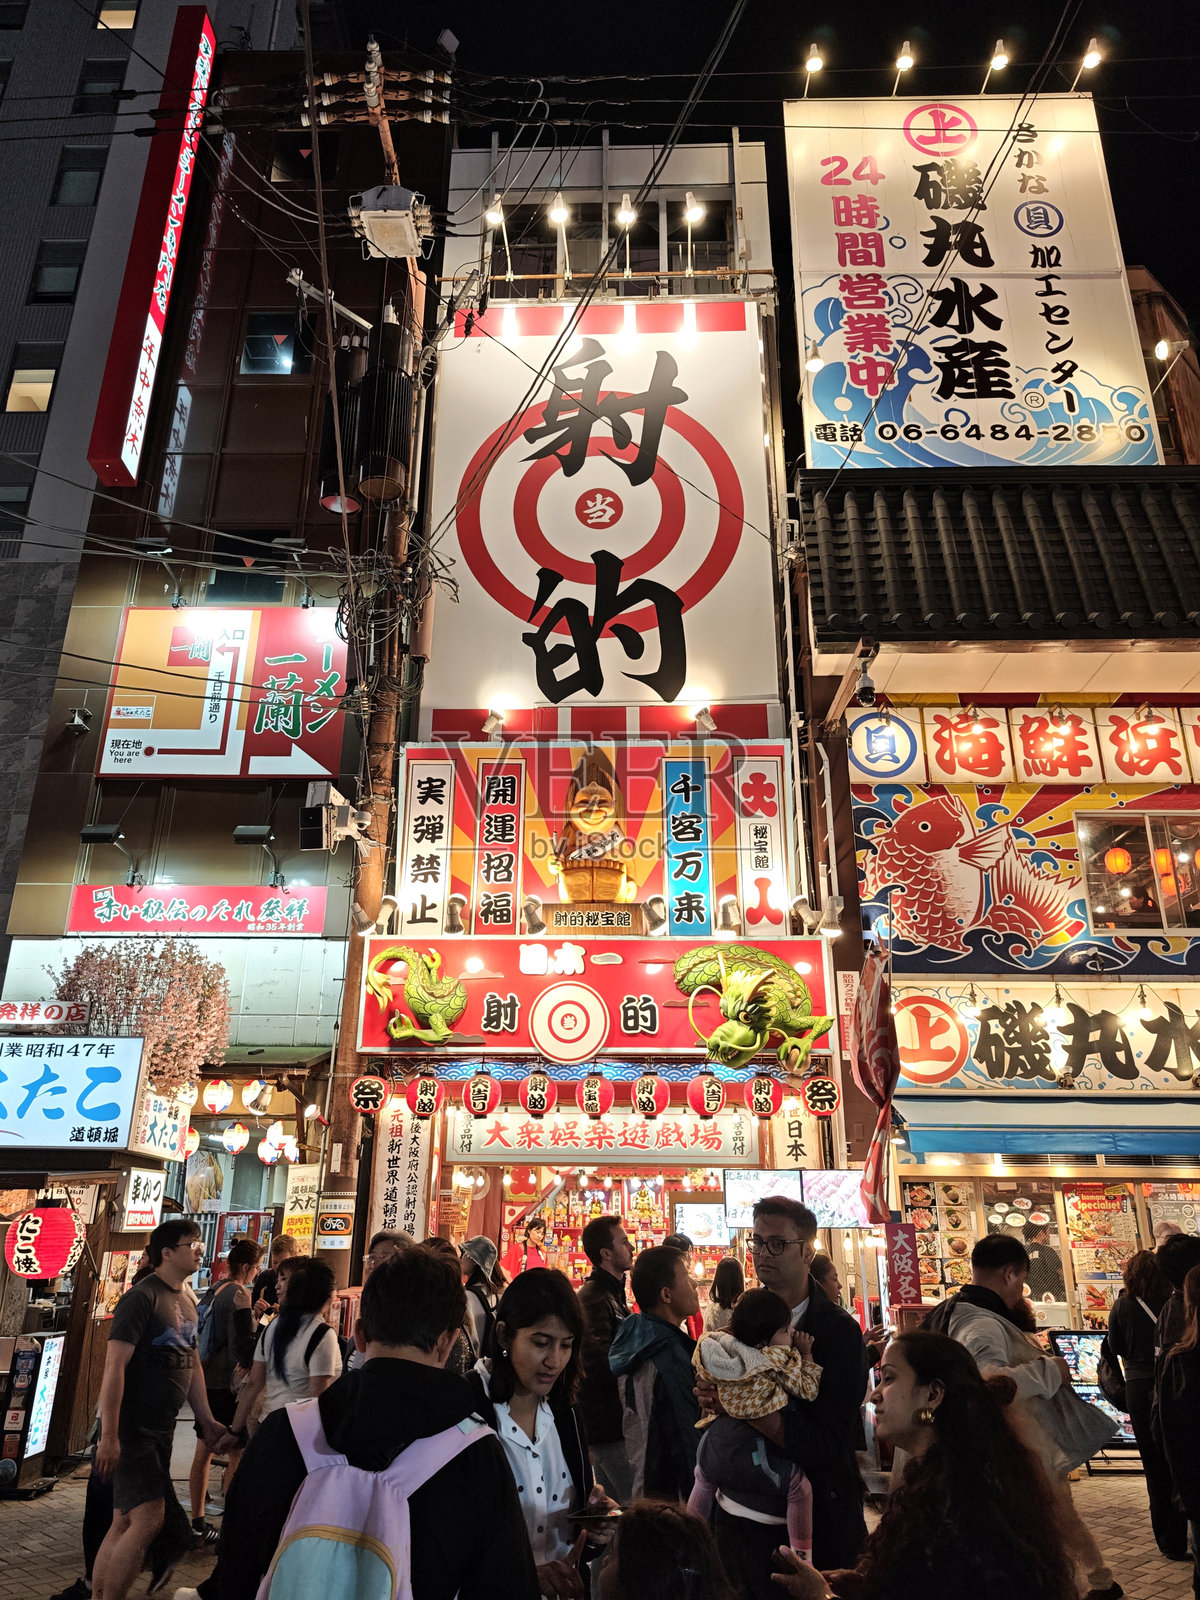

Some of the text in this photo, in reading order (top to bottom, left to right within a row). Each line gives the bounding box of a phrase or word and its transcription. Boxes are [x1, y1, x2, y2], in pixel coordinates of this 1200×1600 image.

[912, 158, 1015, 400] 磯丸水産
[126, 334, 155, 456] 年中無休
[814, 424, 865, 443] 電話
[219, 629, 245, 640] 入口
[208, 671, 225, 724] 千日前通り
[254, 653, 307, 739] 一蘭
[110, 739, 143, 749] 現在地
[406, 776, 447, 926] 実弾禁止
[480, 775, 518, 926] 開運招福
[670, 773, 706, 925] 千客万来
[753, 825, 769, 869] 秘宝館
[553, 911, 631, 928] 射的秘宝館
[0, 1003, 88, 1021] 発祥の店
[483, 994, 659, 1034] 射 的
[0, 1042, 116, 1058] 業昭和47年
[0, 1063, 122, 1122] たこ
[353, 1079, 385, 1110] 祭
[471, 1077, 491, 1112] 大当り
[583, 1079, 600, 1113] 秘宝館
[703, 1078, 722, 1112] 大当り
[807, 1079, 838, 1111] 祭
[69, 1127, 119, 1143] 道頓堀
[480, 1120, 724, 1151] 大衆娯楽遊戯場
[1077, 1200, 1121, 1211] Specialset
[17, 1214, 41, 1274] たこ焼
[892, 1229, 918, 1304] 大阪名
